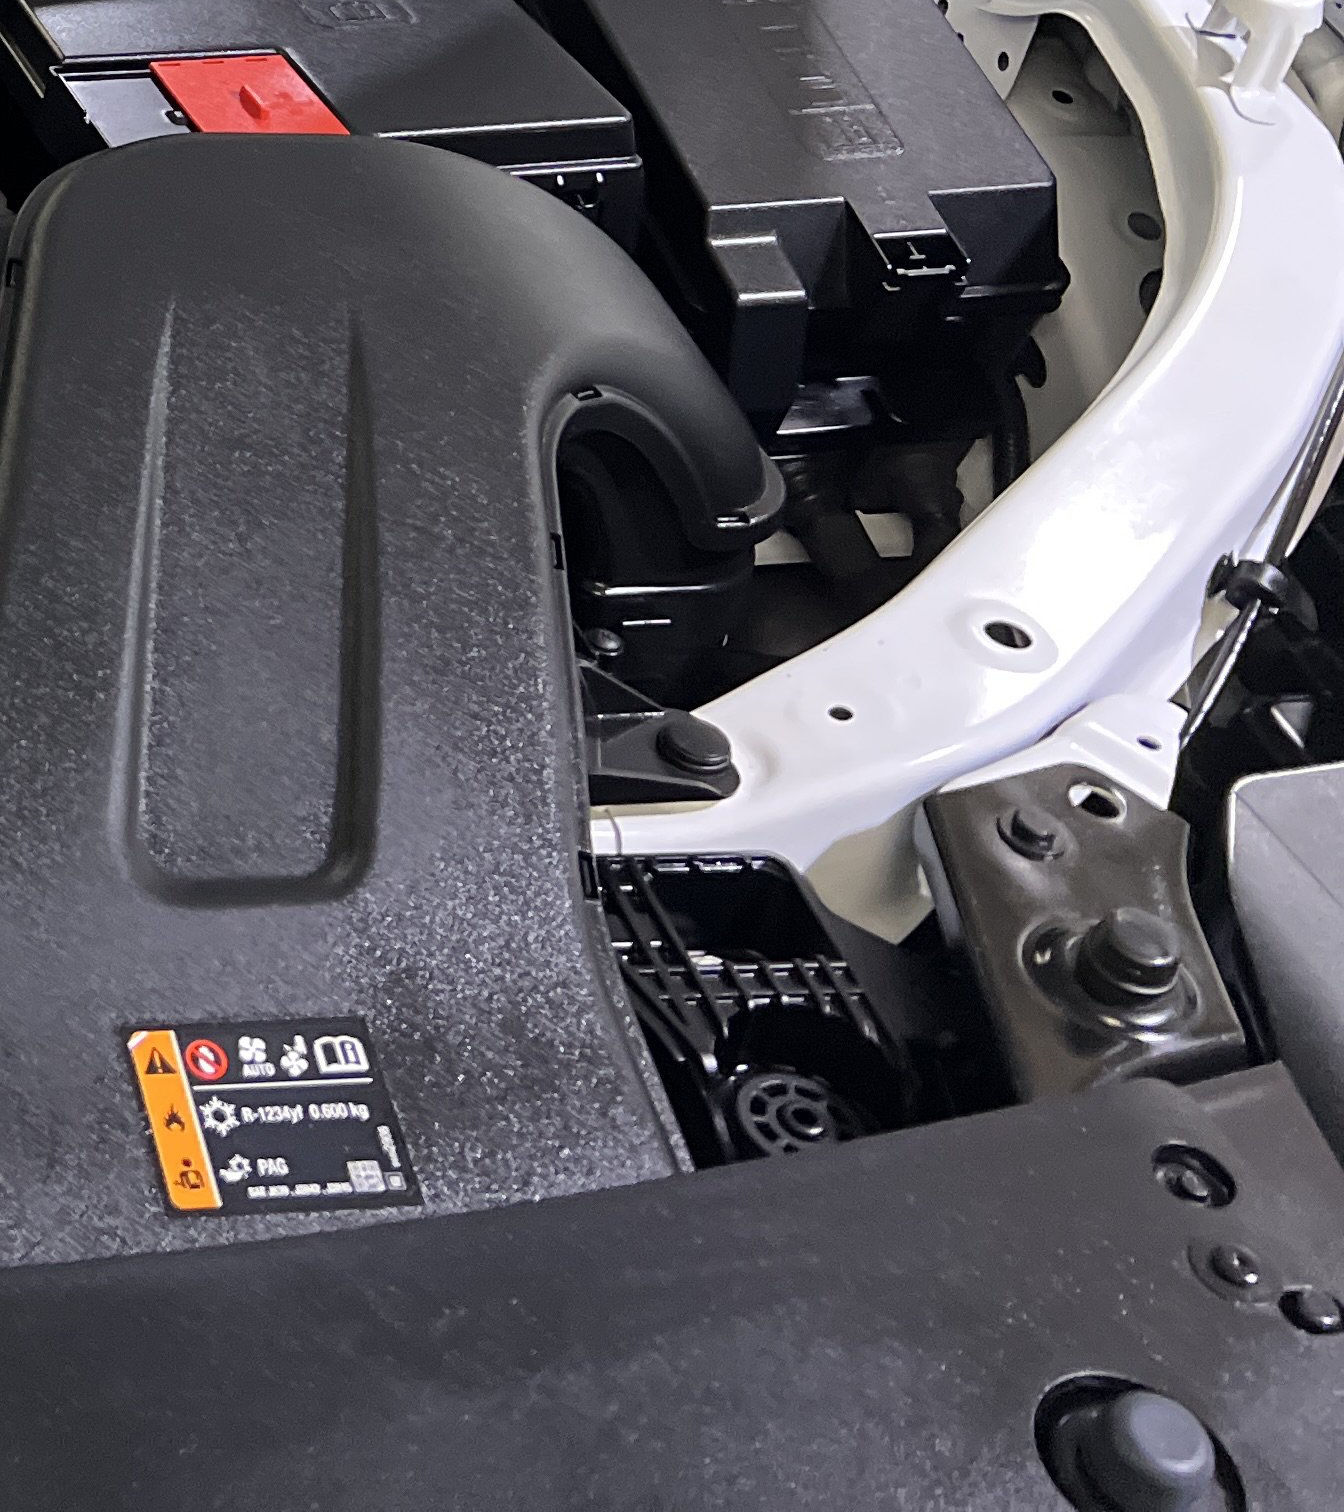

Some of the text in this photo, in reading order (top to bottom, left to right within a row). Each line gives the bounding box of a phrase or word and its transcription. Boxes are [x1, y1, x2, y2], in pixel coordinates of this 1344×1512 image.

[242, 1062, 276, 1077] AUTO
[348, 1101, 371, 1122] kg
[256, 1156, 290, 1178] PAG
